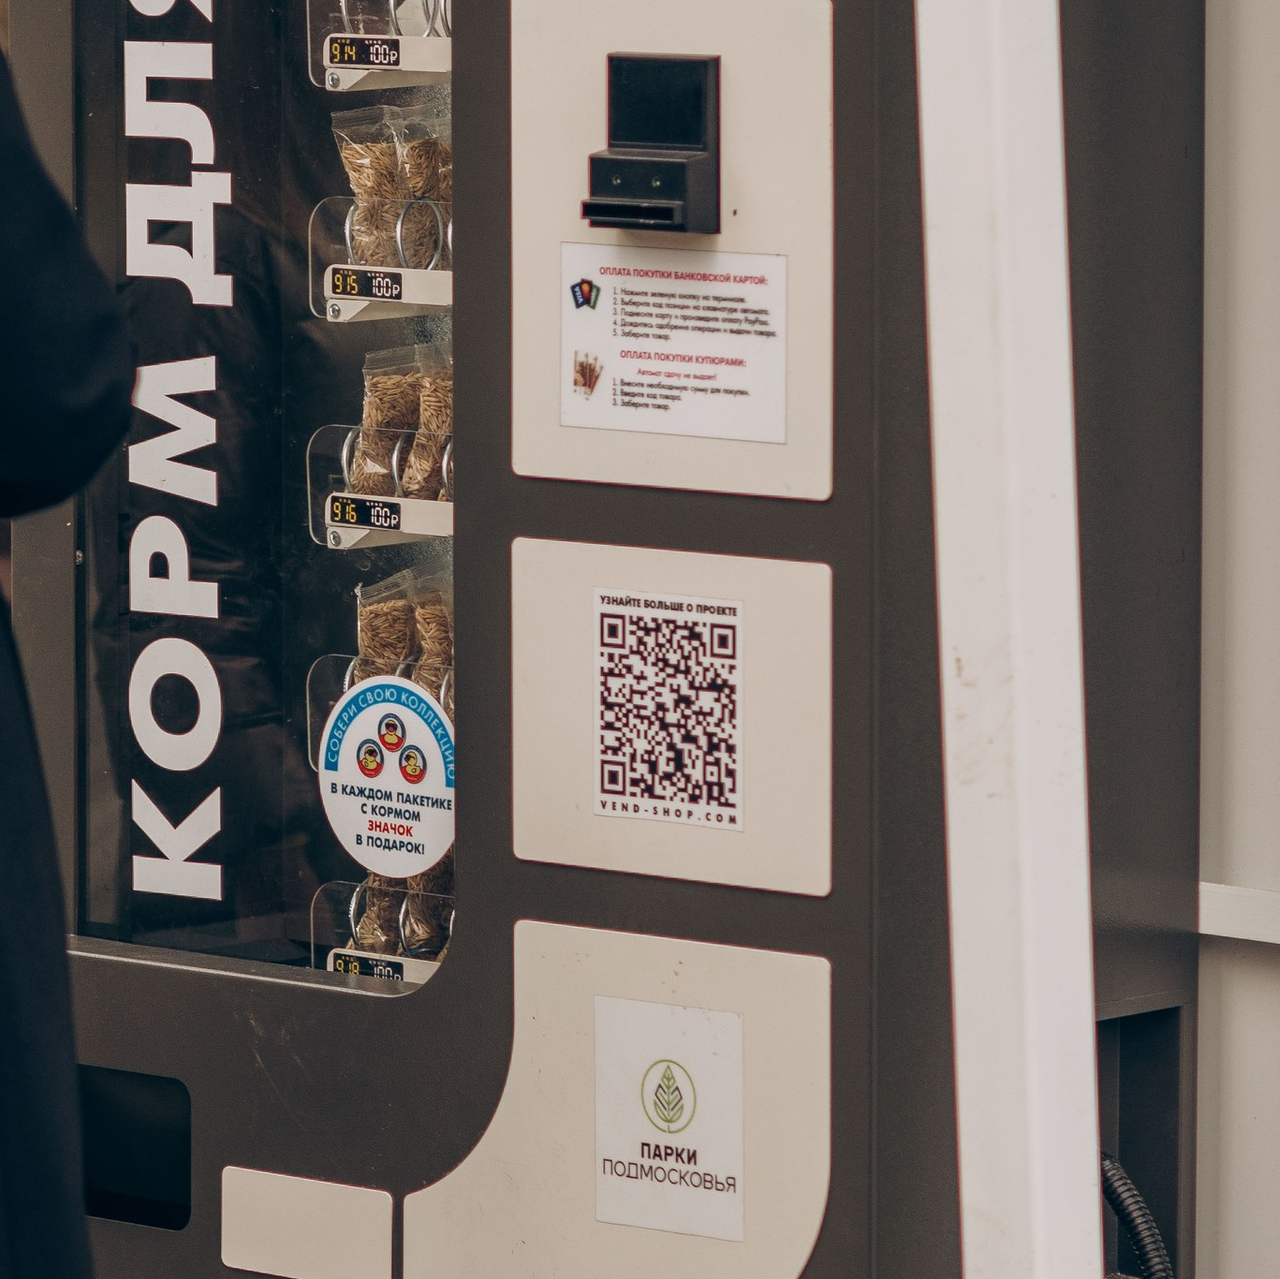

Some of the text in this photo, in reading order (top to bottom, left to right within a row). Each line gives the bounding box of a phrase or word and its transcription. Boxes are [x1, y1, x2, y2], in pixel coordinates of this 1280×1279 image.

[332, 43, 356, 62] 914
[334, 274, 358, 294] 915
[599, 266, 769, 285] ОПЛАТА ПОКУПКИ БАНКОВСКОЙ КАРТОЙ:
[620, 350, 747, 367] ОПЛАТА ПОКУПКИ КУПЮРАМИ:
[333, 502, 356, 523] 916
[600, 595, 738, 617] УЗНАЙТЕ БОЛЬШЕ О ПРОЕКТЕ
[128, 355, 224, 901] КОРМ
[328, 688, 455, 779] СОБЕРИ СВОЮ КОЛЛЕКЦИЮ
[331, 782, 452, 810] В КАЖДОМ ПАКЕТИКЕ
[361, 803, 421, 822] С КОРМОМ
[600, 800, 737, 824] VEND-SHOP.COM
[368, 820, 413, 837] ЗНАЧОК
[356, 834, 425, 855] В ПОДАРОК!
[641, 1142, 697, 1165] ПАРКИ
[602, 1158, 737, 1193] ПОДМОСКОВЬЯ
